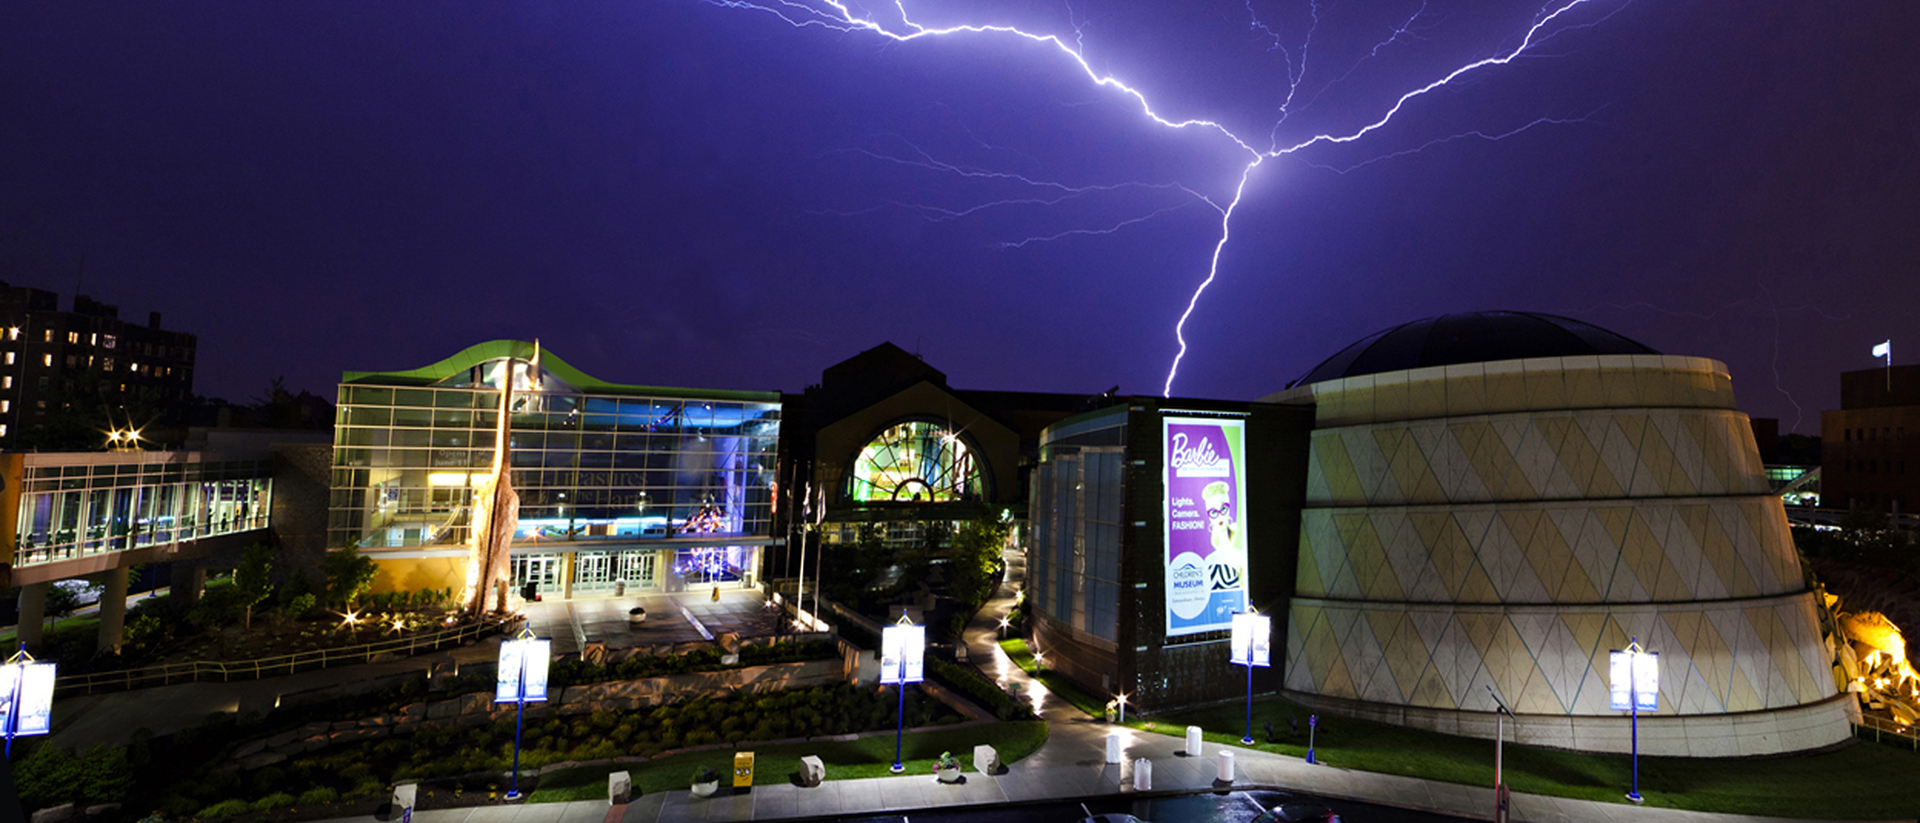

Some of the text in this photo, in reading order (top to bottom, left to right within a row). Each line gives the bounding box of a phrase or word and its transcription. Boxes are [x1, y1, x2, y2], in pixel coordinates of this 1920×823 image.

[1171, 432, 1220, 469] Barbie
[1171, 497, 1195, 508] Lights.
[1171, 509, 1200, 518] Camera.
[1173, 580, 1204, 589] MUSEUM
